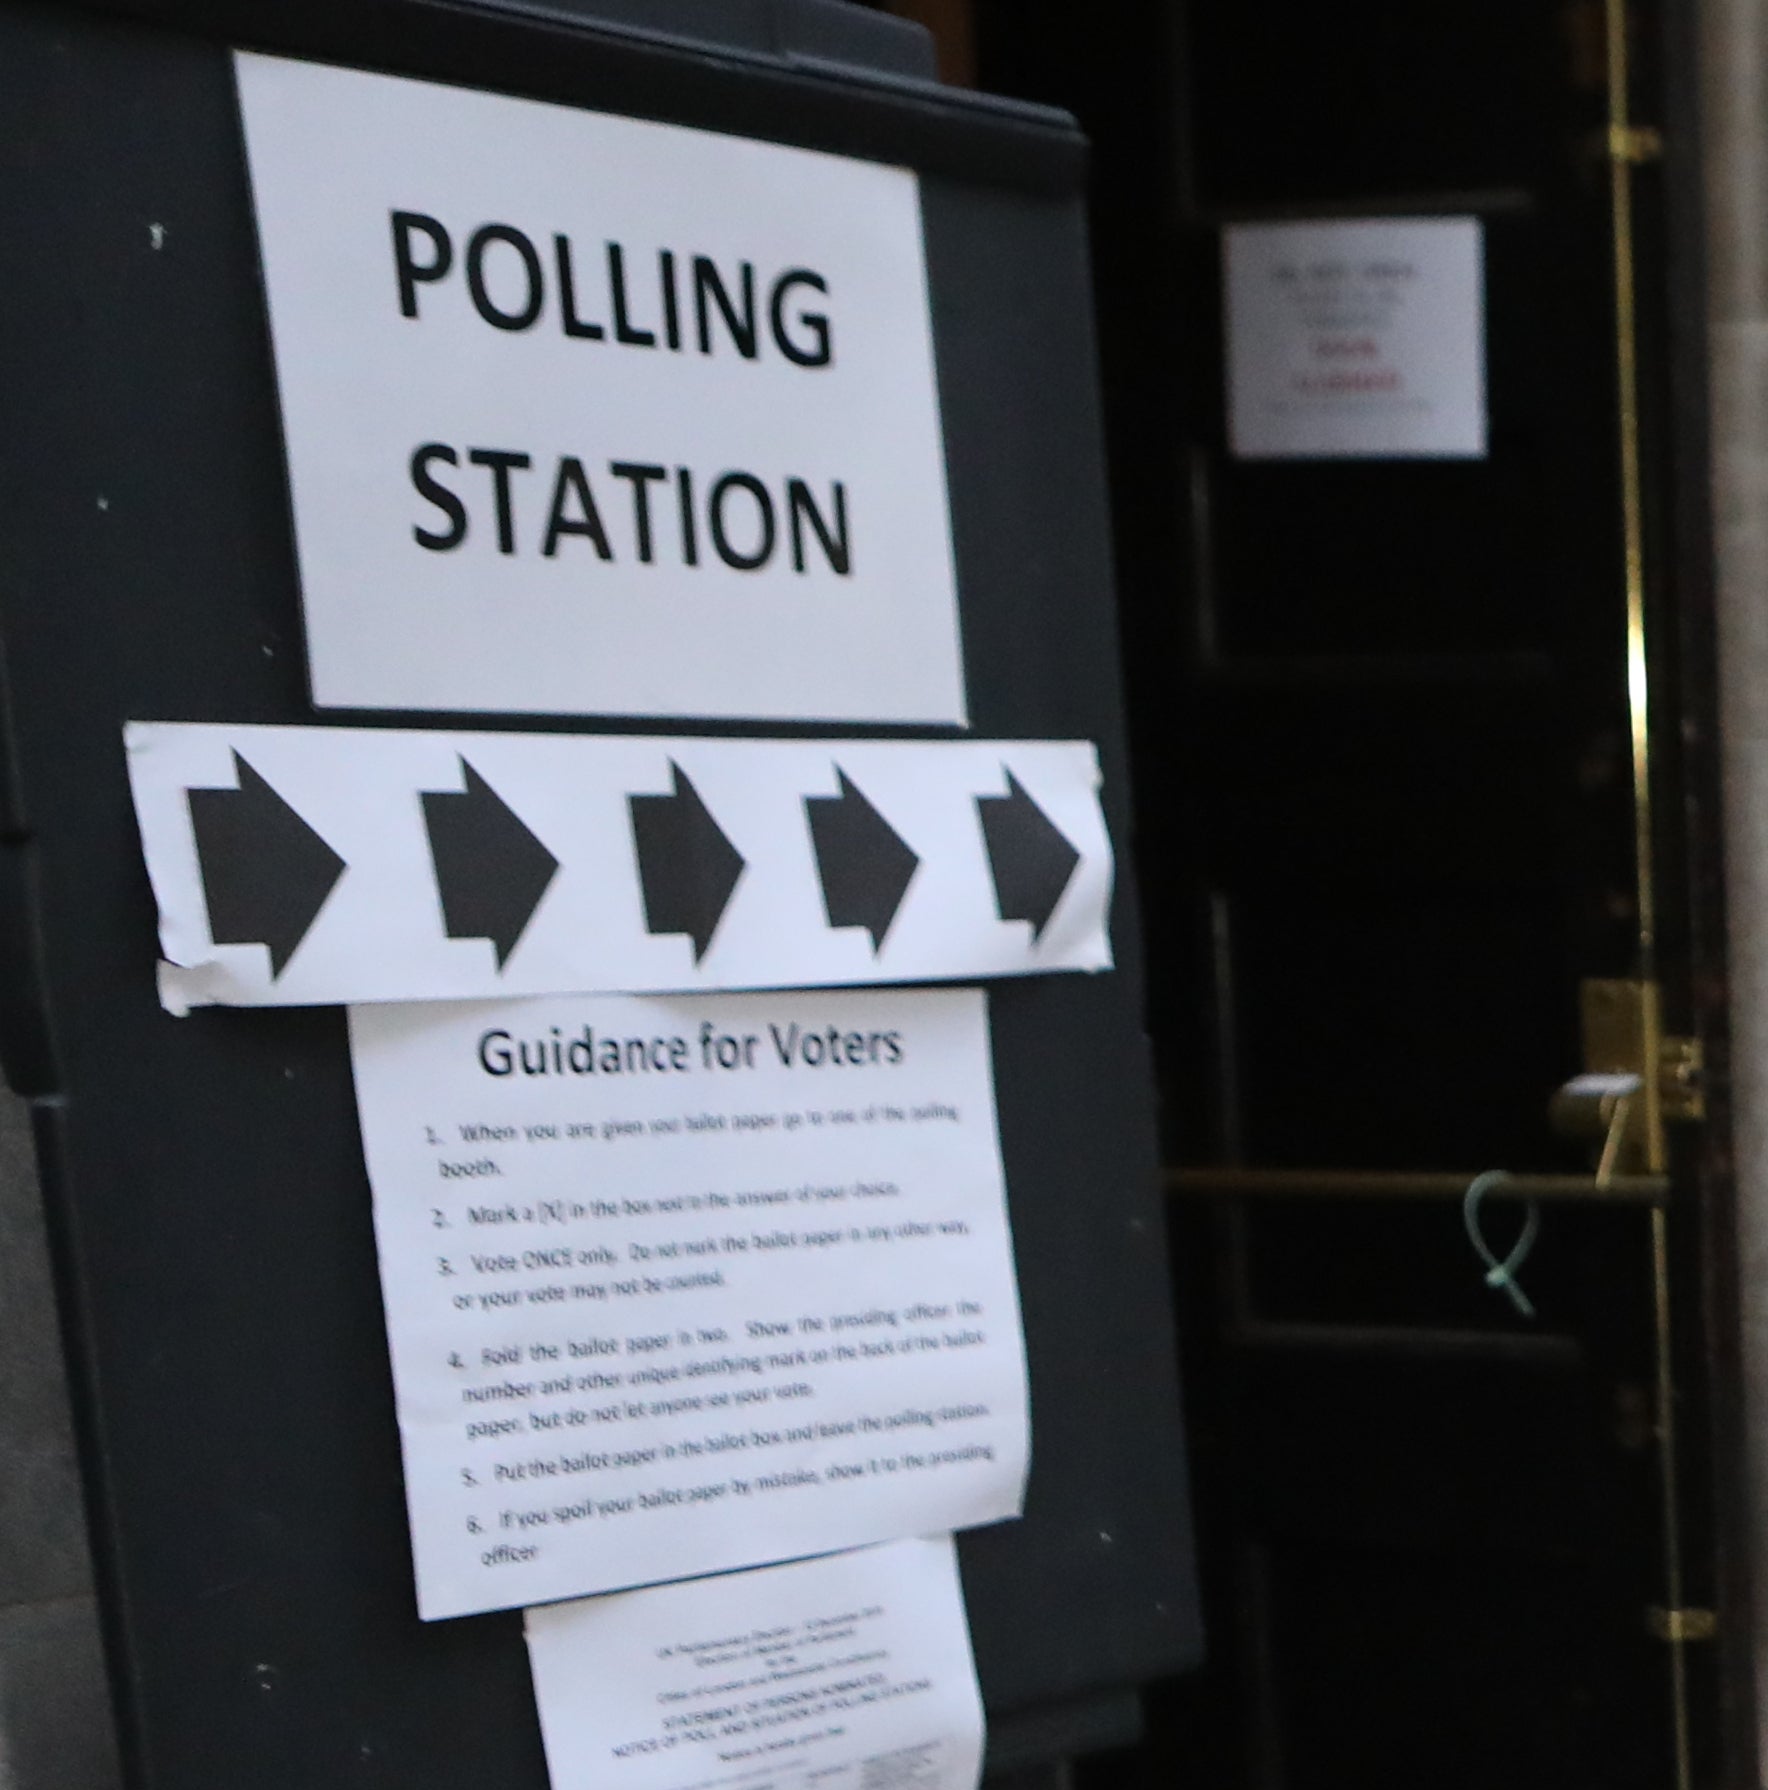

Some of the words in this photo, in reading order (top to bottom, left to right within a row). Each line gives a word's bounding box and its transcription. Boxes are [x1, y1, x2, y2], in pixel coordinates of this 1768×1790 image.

[389, 208, 832, 368] POLLING
[408, 442, 854, 578] STATION
[477, 1024, 690, 1077] Guidance
[701, 1020, 760, 1070] for
[766, 1020, 904, 1068] Voters
[459, 1123, 516, 1142] When
[523, 1124, 559, 1144] you
[565, 1123, 596, 1140] are
[601, 1119, 644, 1142] given
[467, 1203, 518, 1225] Mark
[522, 1206, 534, 1221] a
[590, 1198, 618, 1218] the
[621, 1197, 651, 1216] box
[707, 1192, 729, 1209] the
[736, 1188, 789, 1206] answer
[470, 1251, 518, 1274] Vote
[522, 1246, 571, 1270] ONCE
[723, 1233, 747, 1253] the
[753, 1229, 797, 1252] ballot
[803, 1229, 841, 1250] paper
[867, 1224, 890, 1243] any
[896, 1220, 932, 1239] other
[452, 1292, 473, 1311] or
[478, 1289, 519, 1314] your
[526, 1284, 565, 1305] vote
[571, 1281, 607, 1304] may
[612, 1277, 640, 1297] not
[642, 1275, 662, 1294] be
[481, 1347, 522, 1366] Fold
[529, 1342, 560, 1363] the
[567, 1336, 618, 1359] ballot
[625, 1333, 671, 1356] paper
[745, 1319, 789, 1338] Show
[797, 1316, 823, 1333] the
[829, 1308, 898, 1332] presiding
[904, 1302, 949, 1322] officer
[957, 1300, 983, 1317] the
[462, 1381, 533, 1402] number
[539, 1375, 573, 1395] and
[577, 1371, 623, 1392] other
[628, 1367, 679, 1388] unique
[769, 1351, 806, 1369] mark
[809, 1348, 828, 1364] on
[834, 1345, 856, 1362] the
[859, 1339, 896, 1358] back
[915, 1334, 939, 1351] the
[942, 1329, 985, 1349] ballot
[529, 1410, 561, 1432] but
[565, 1406, 588, 1426] do
[594, 1403, 622, 1422] not
[626, 1400, 646, 1418] let
[650, 1395, 701, 1417] anyone
[734, 1387, 769, 1405] your
[494, 1462, 526, 1483] Put
[528, 1458, 557, 1478] the
[560, 1452, 609, 1475] ballot
[613, 1447, 657, 1469] paper
[680, 1440, 702, 1456] the
[705, 1432, 748, 1452] ballot
[751, 1430, 780, 1447] box
[786, 1425, 813, 1443] and
[817, 1420, 855, 1439] leave
[858, 1416, 882, 1433] the
[885, 1408, 935, 1430] polling
[516, 1508, 548, 1530] you
[553, 1498, 592, 1525] spoil
[596, 1497, 632, 1519] your
[638, 1489, 682, 1510] ballot
[687, 1482, 727, 1503] paper
[731, 1478, 749, 1496] by
[825, 1462, 863, 1482] show
[882, 1456, 898, 1473] to
[901, 1452, 925, 1469] the
[930, 1443, 994, 1466] presiding
